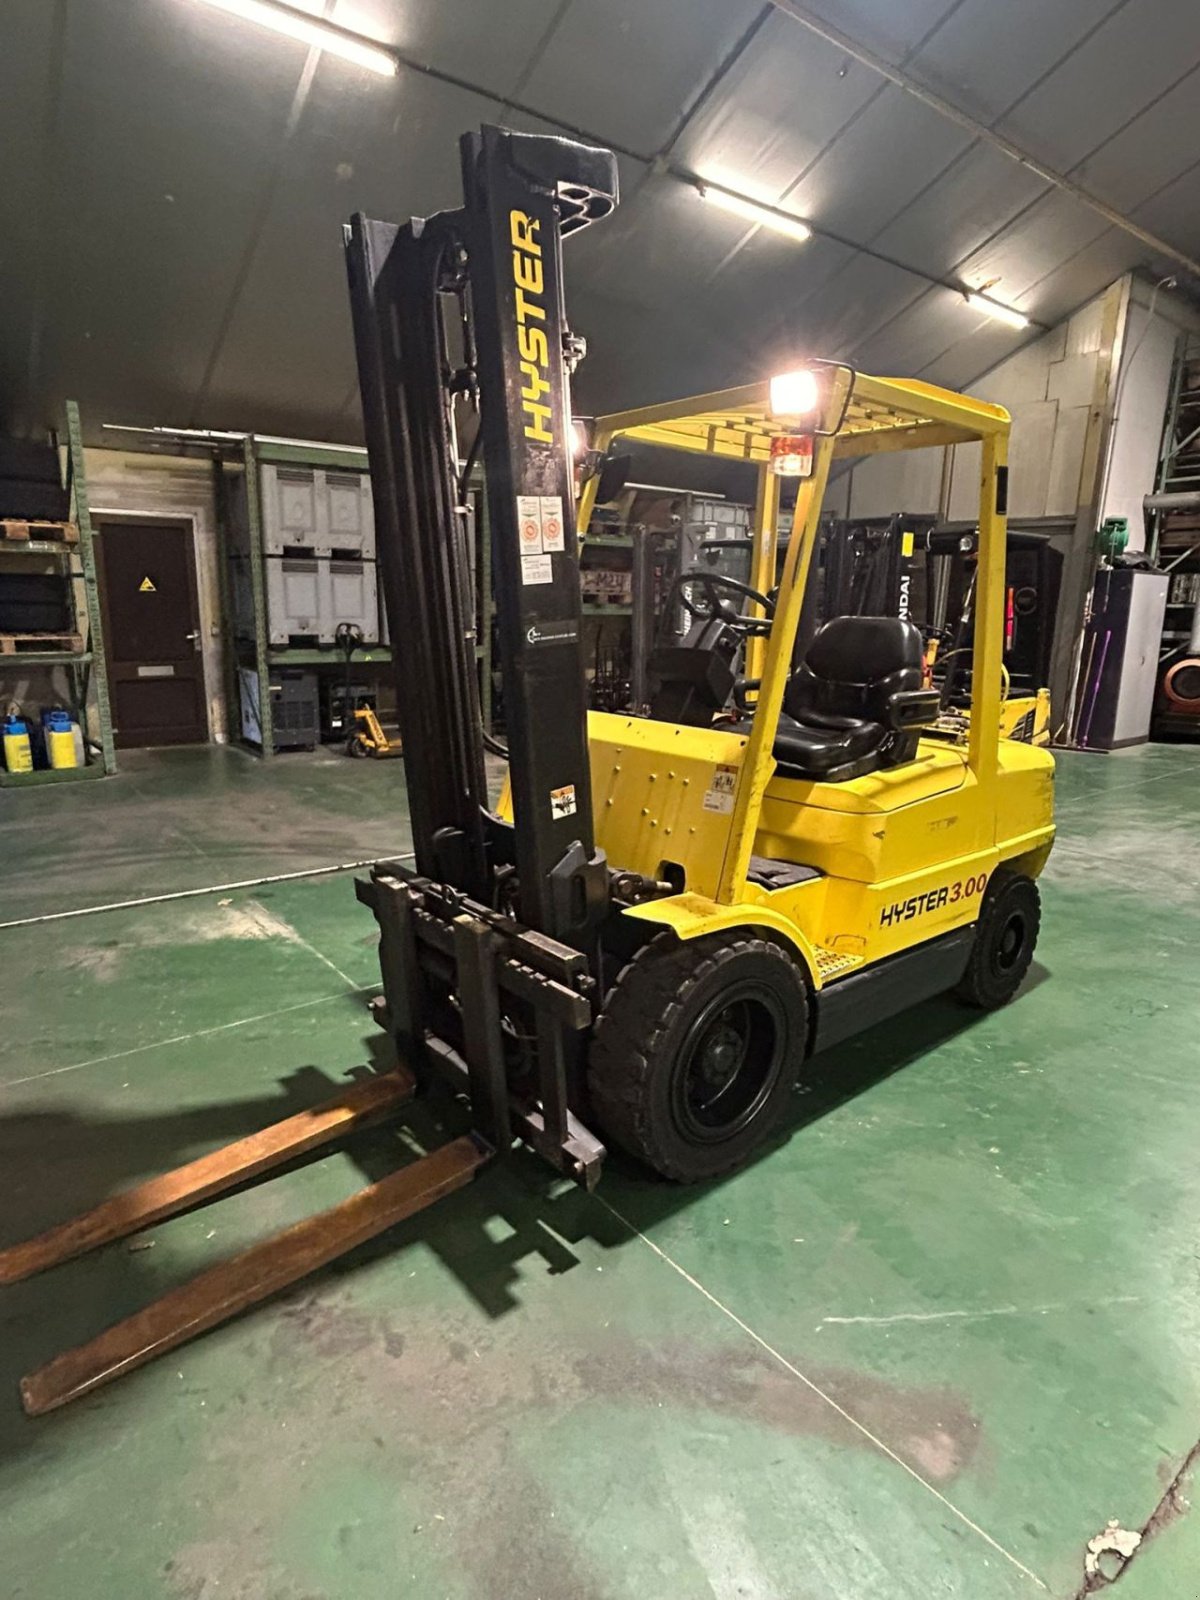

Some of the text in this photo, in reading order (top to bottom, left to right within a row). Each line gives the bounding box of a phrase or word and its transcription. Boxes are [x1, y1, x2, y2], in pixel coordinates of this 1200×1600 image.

[510, 209, 553, 443] HYSTER
[880, 873, 987, 926] HYSTER 3.00
